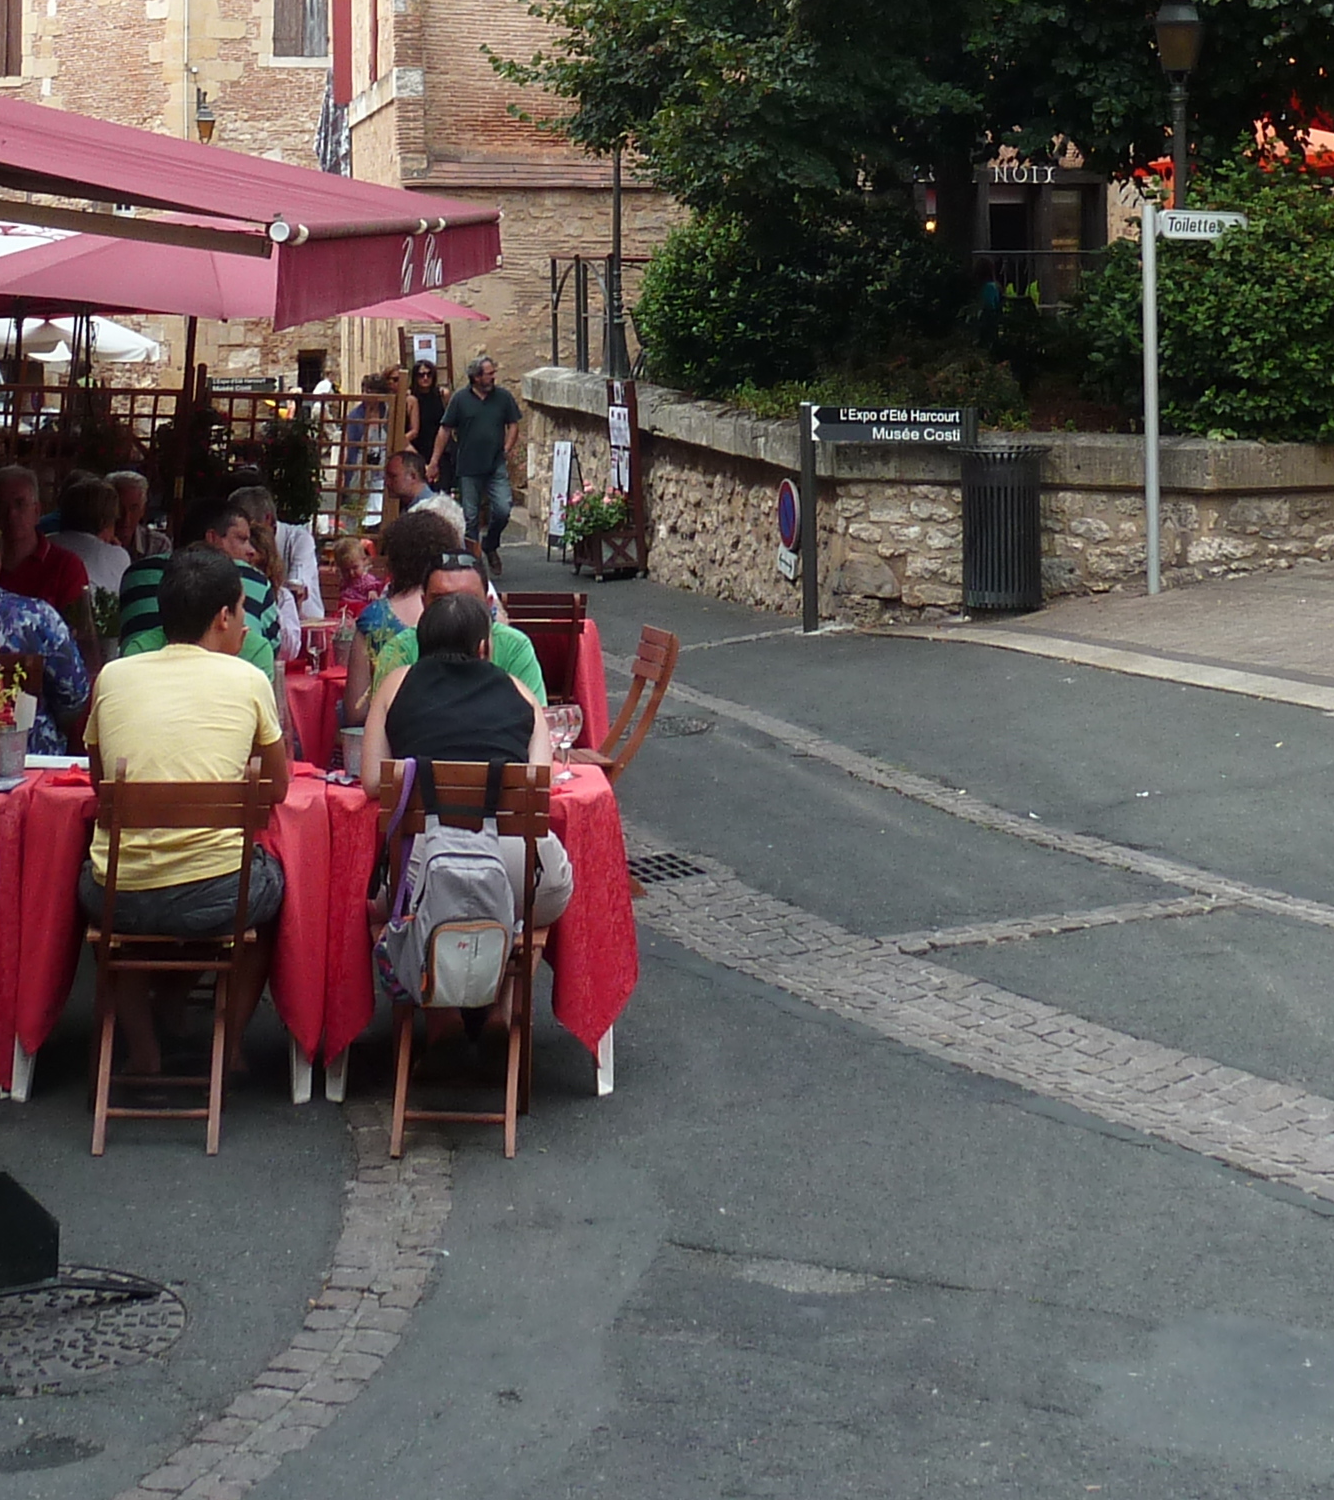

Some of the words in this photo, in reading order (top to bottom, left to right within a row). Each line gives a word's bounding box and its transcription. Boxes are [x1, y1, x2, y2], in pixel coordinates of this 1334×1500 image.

[993, 165, 1056, 184] NOIX
[1168, 216, 1224, 233] Toilettes
[840, 408, 877, 423] L'Expo
[880, 408, 908, 421] d'Eté
[910, 410, 960, 423] Harcourt
[872, 427, 920, 440] Musée
[923, 428, 961, 441] Costi
